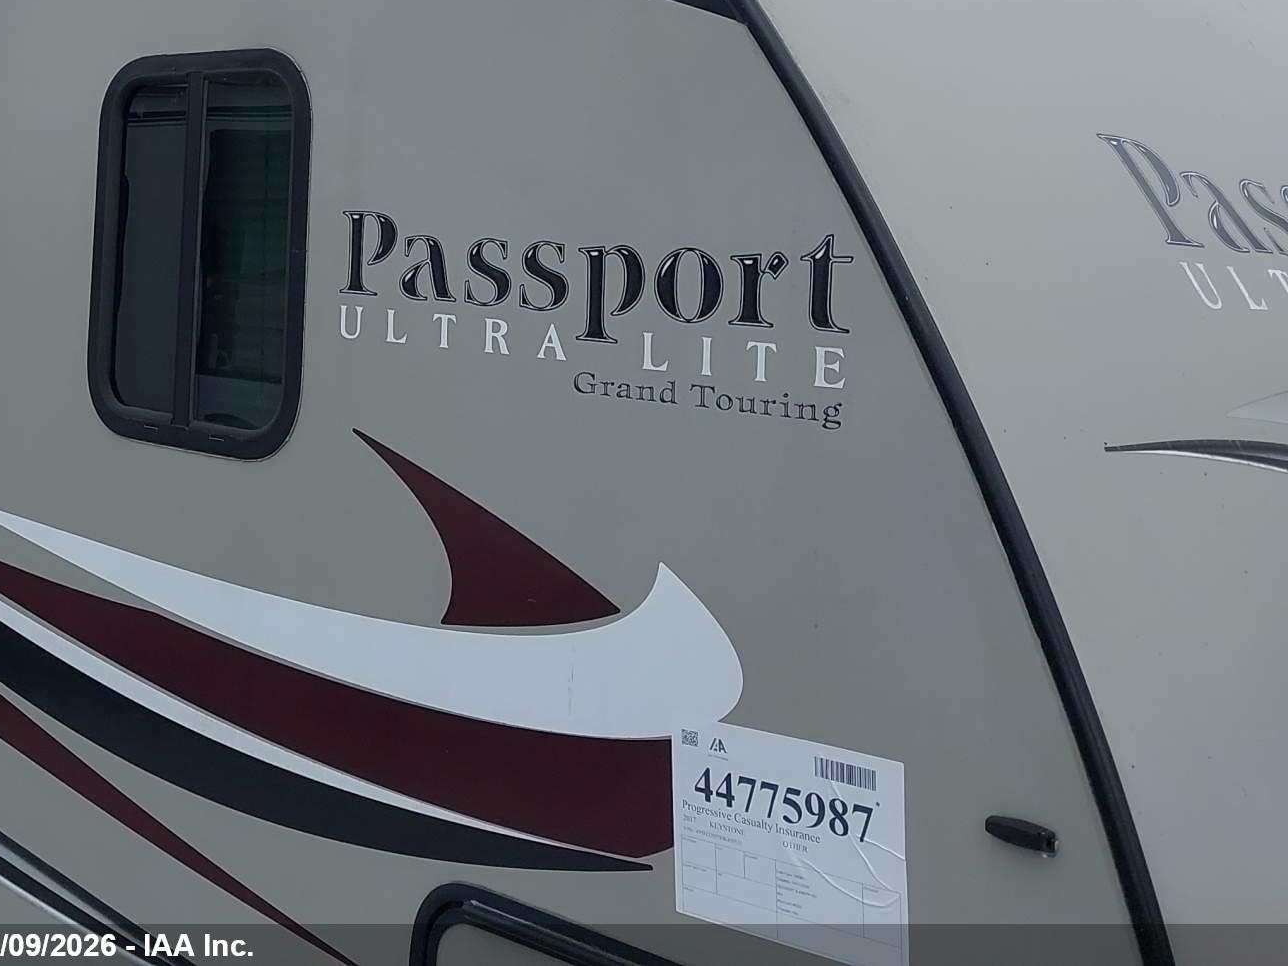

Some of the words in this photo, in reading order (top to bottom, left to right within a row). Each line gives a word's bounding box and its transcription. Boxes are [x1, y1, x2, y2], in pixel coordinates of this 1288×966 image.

[1096, 133, 1288, 256] Pas
[338, 210, 854, 344] Passport
[339, 304, 568, 362] ULTRA
[642, 331, 847, 390] LITE
[573, 371, 678, 405] Grand
[690, 383, 843, 430] Touring
[682, 799, 732, 822] Progressive
[734, 812, 773, 834] Casualty
[775, 823, 821, 844] Insurance
[694, 767, 874, 843] 44775987
